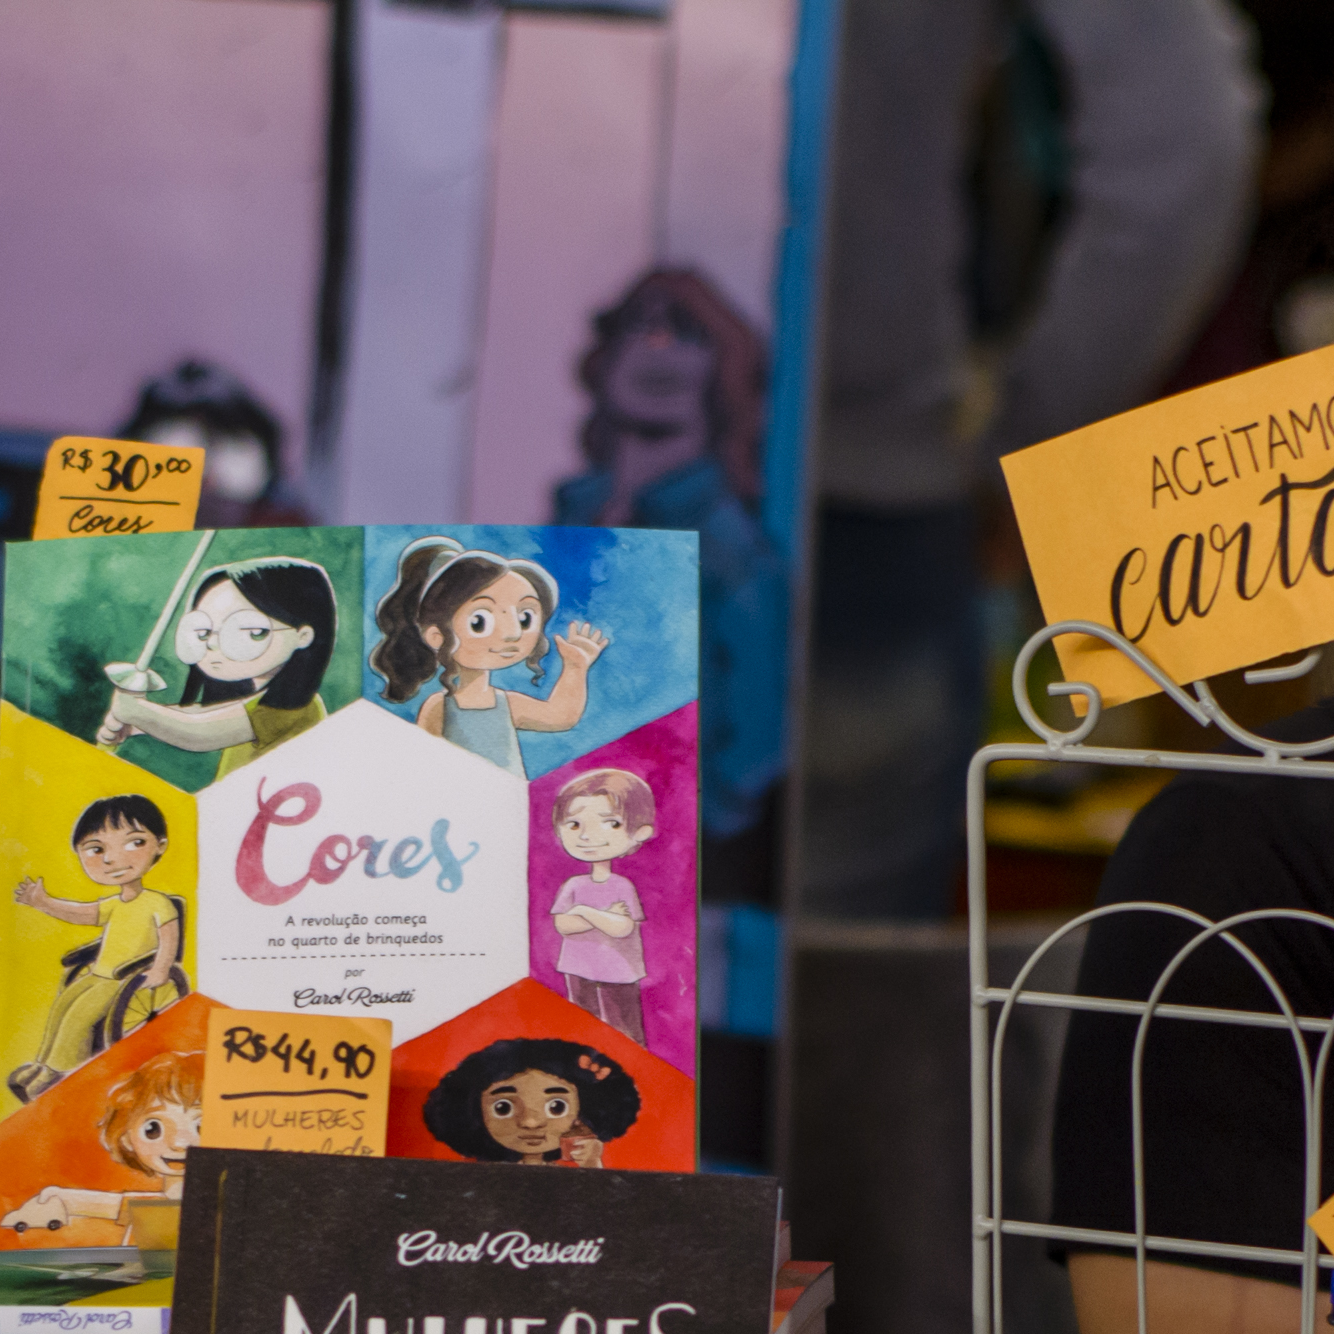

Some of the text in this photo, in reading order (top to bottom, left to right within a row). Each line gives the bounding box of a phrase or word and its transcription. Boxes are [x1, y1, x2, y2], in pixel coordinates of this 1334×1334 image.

[68, 504, 154, 535] Cores
[235, 776, 481, 906] Cores
[284, 913, 427, 929] A revolução começa
[268, 931, 444, 949] no quarto de brinquedos
[344, 968, 366, 979] por
[293, 987, 415, 1008] Carol Rossetti
[232, 1108, 366, 1131] MULHERES
[397, 1230, 605, 1270] Carol Rossetti
[18, 1309, 133, 1331] Carol Rossetti
